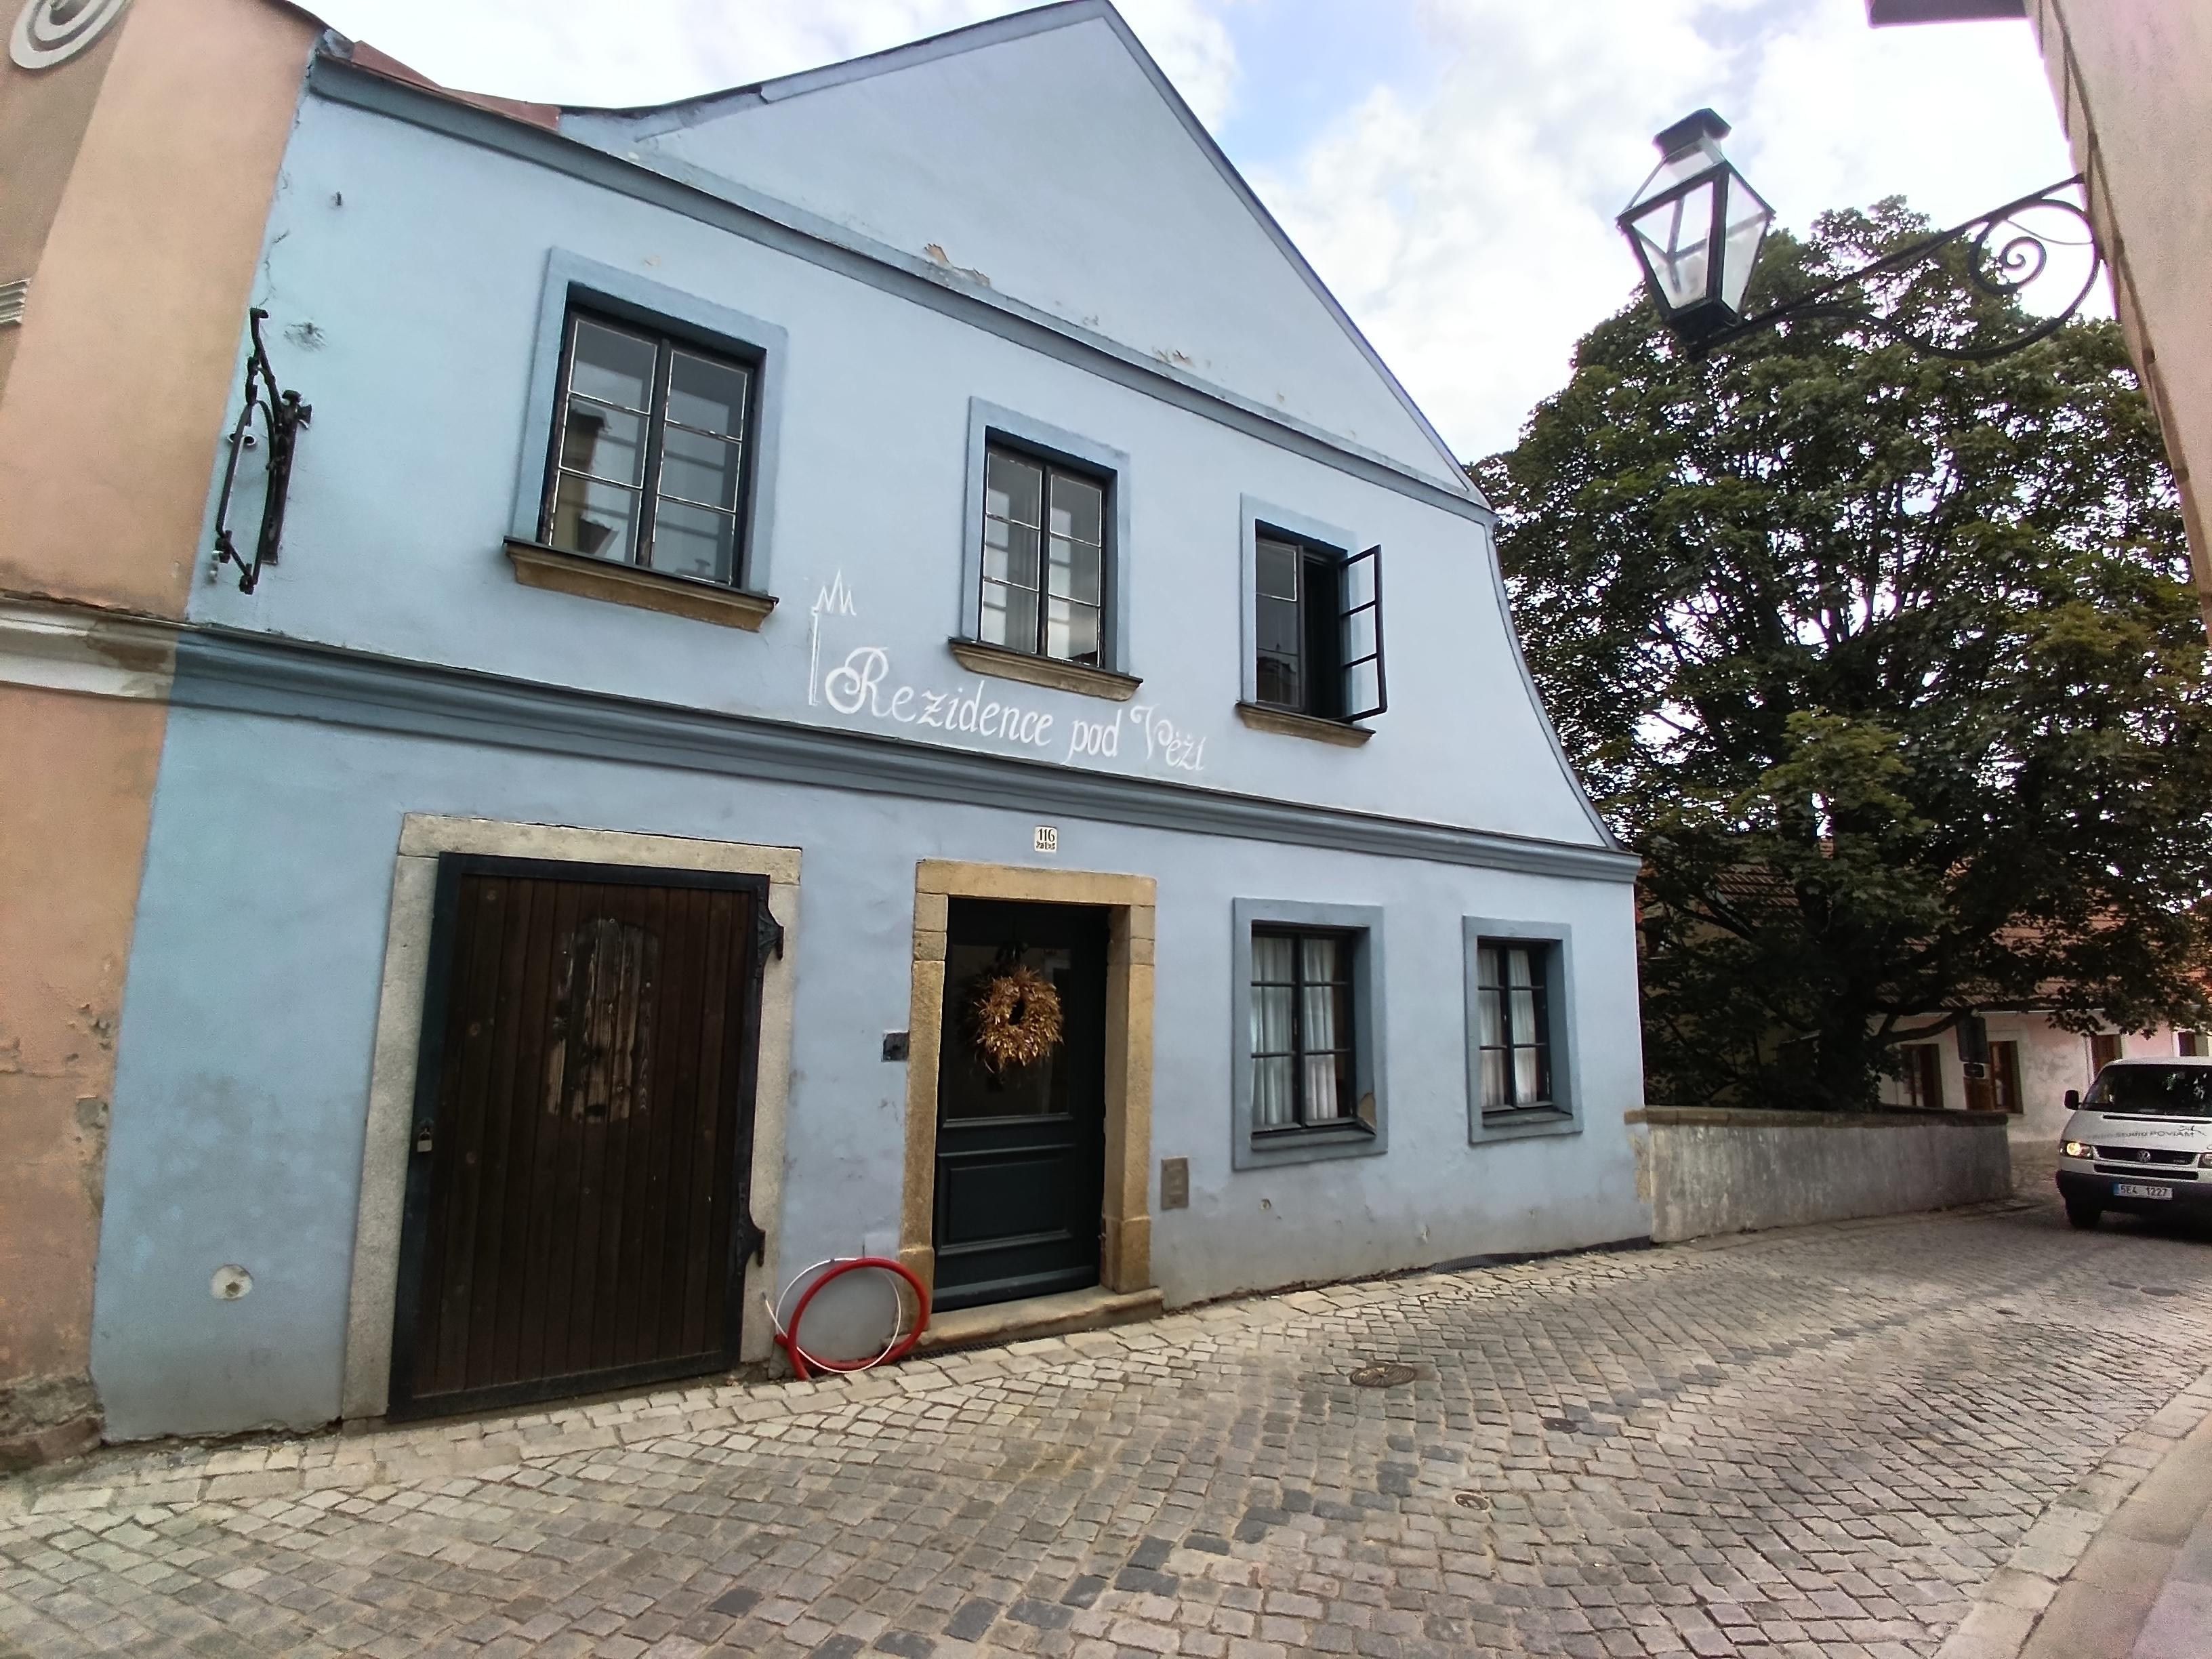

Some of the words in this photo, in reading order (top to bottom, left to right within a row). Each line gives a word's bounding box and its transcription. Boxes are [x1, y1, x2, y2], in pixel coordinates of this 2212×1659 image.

[825, 647, 1053, 745] Rezidence
[1064, 710, 1122, 765] pod
[1038, 828, 1055, 842] 116
